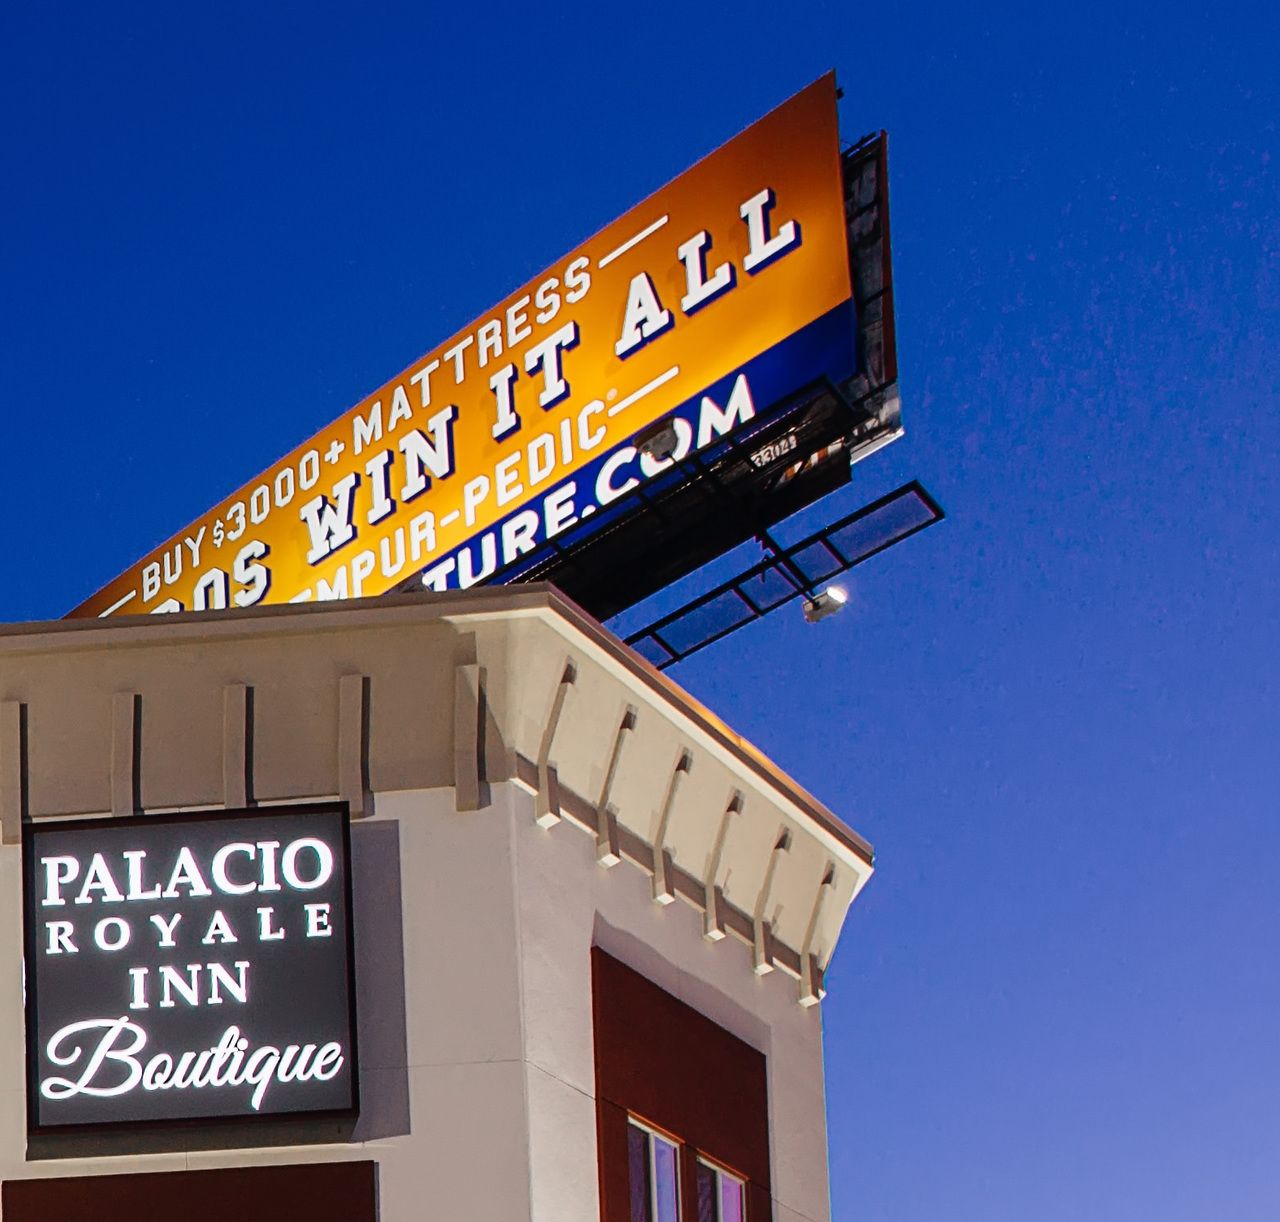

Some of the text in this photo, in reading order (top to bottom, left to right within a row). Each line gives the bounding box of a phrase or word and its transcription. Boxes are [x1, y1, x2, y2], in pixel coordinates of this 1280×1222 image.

[299, 403, 459, 566] WIN
[489, 320, 580, 443] IT
[614, 187, 802, 361] ALL
[141, 525, 206, 602] BUY
[352, 256, 591, 456] MATTRESS
[40, 837, 334, 906] PALACIO
[45, 903, 333, 955] ROYALE
[128, 960, 251, 1010] INN
[40, 1016, 345, 1110] Boutique
